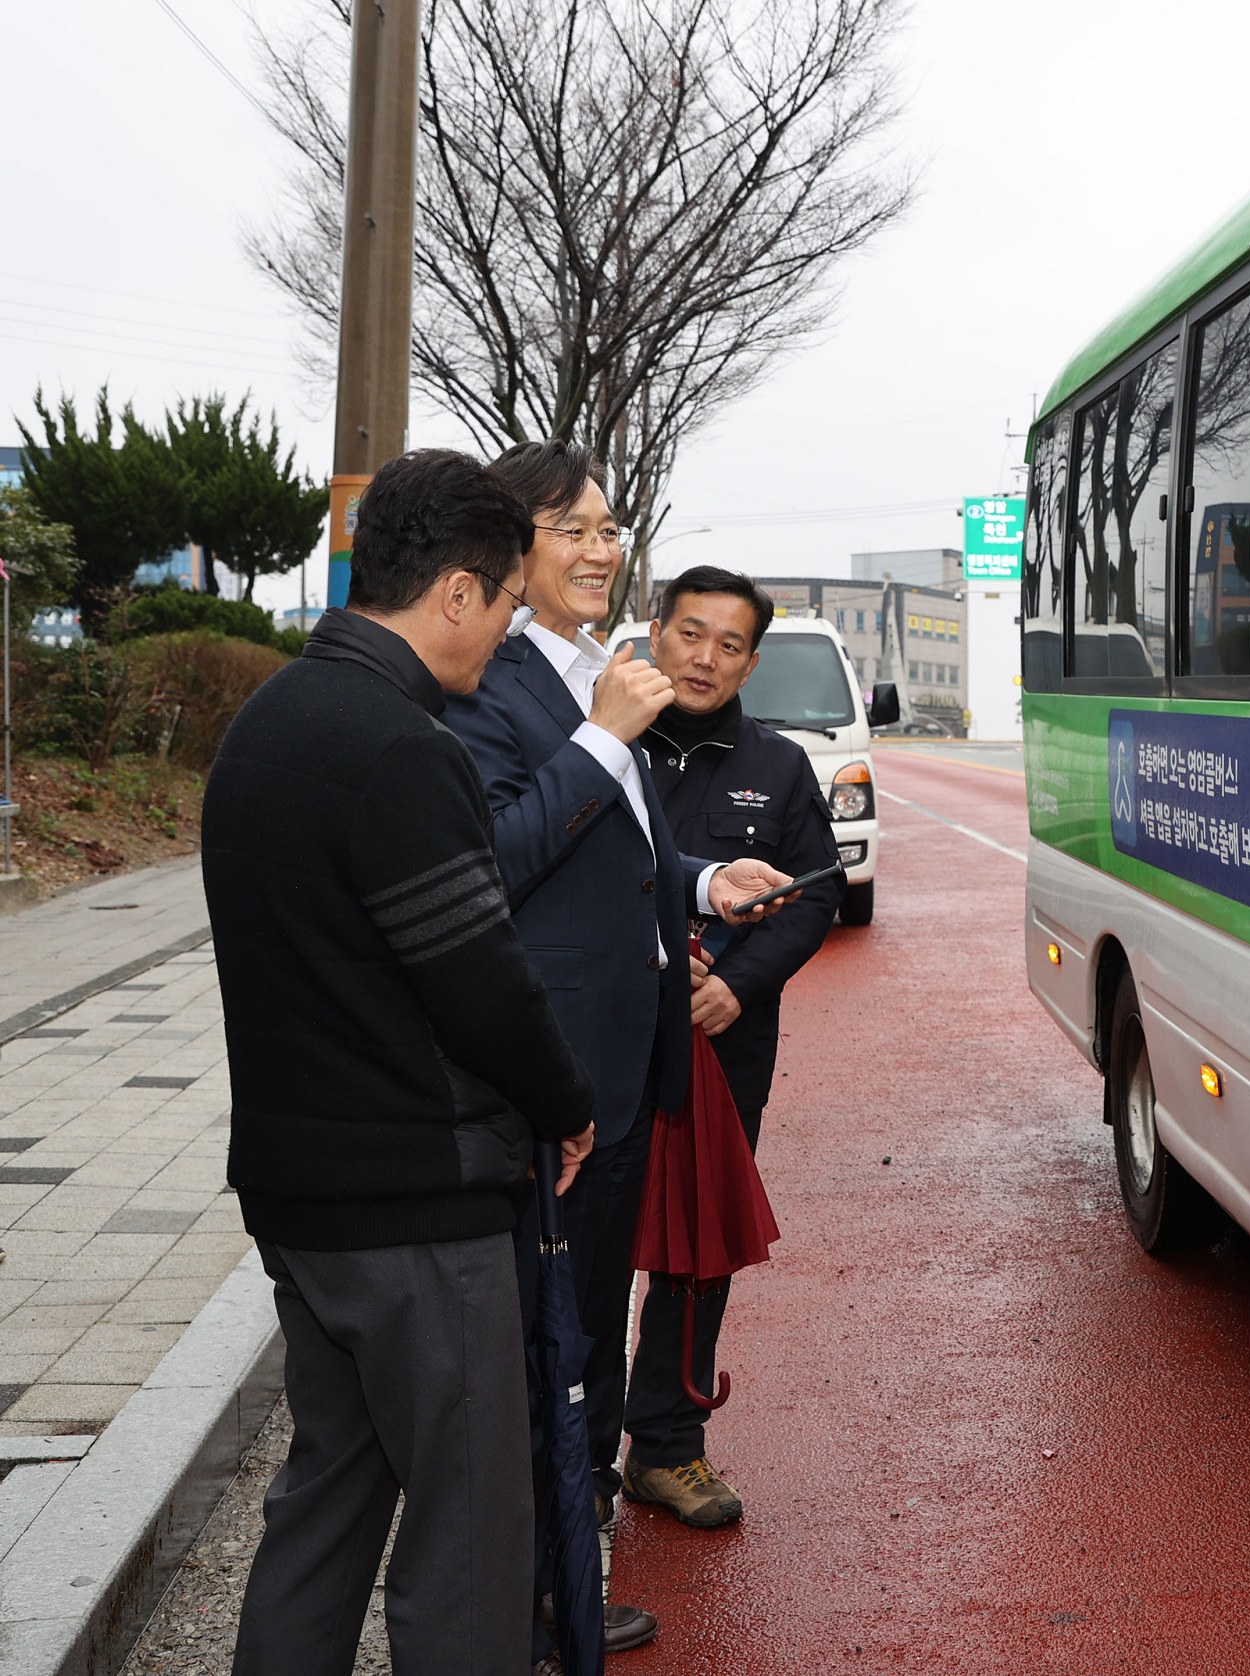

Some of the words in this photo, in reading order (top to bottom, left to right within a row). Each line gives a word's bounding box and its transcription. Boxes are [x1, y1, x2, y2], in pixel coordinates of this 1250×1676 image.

[1138, 743, 1168, 785] 호출하면
[1169, 748, 1187, 789] 오는
[1155, 801, 1172, 845] 앱을
[1172, 806, 1209, 853] 설치하고
[1209, 817, 1240, 867] 호출해
